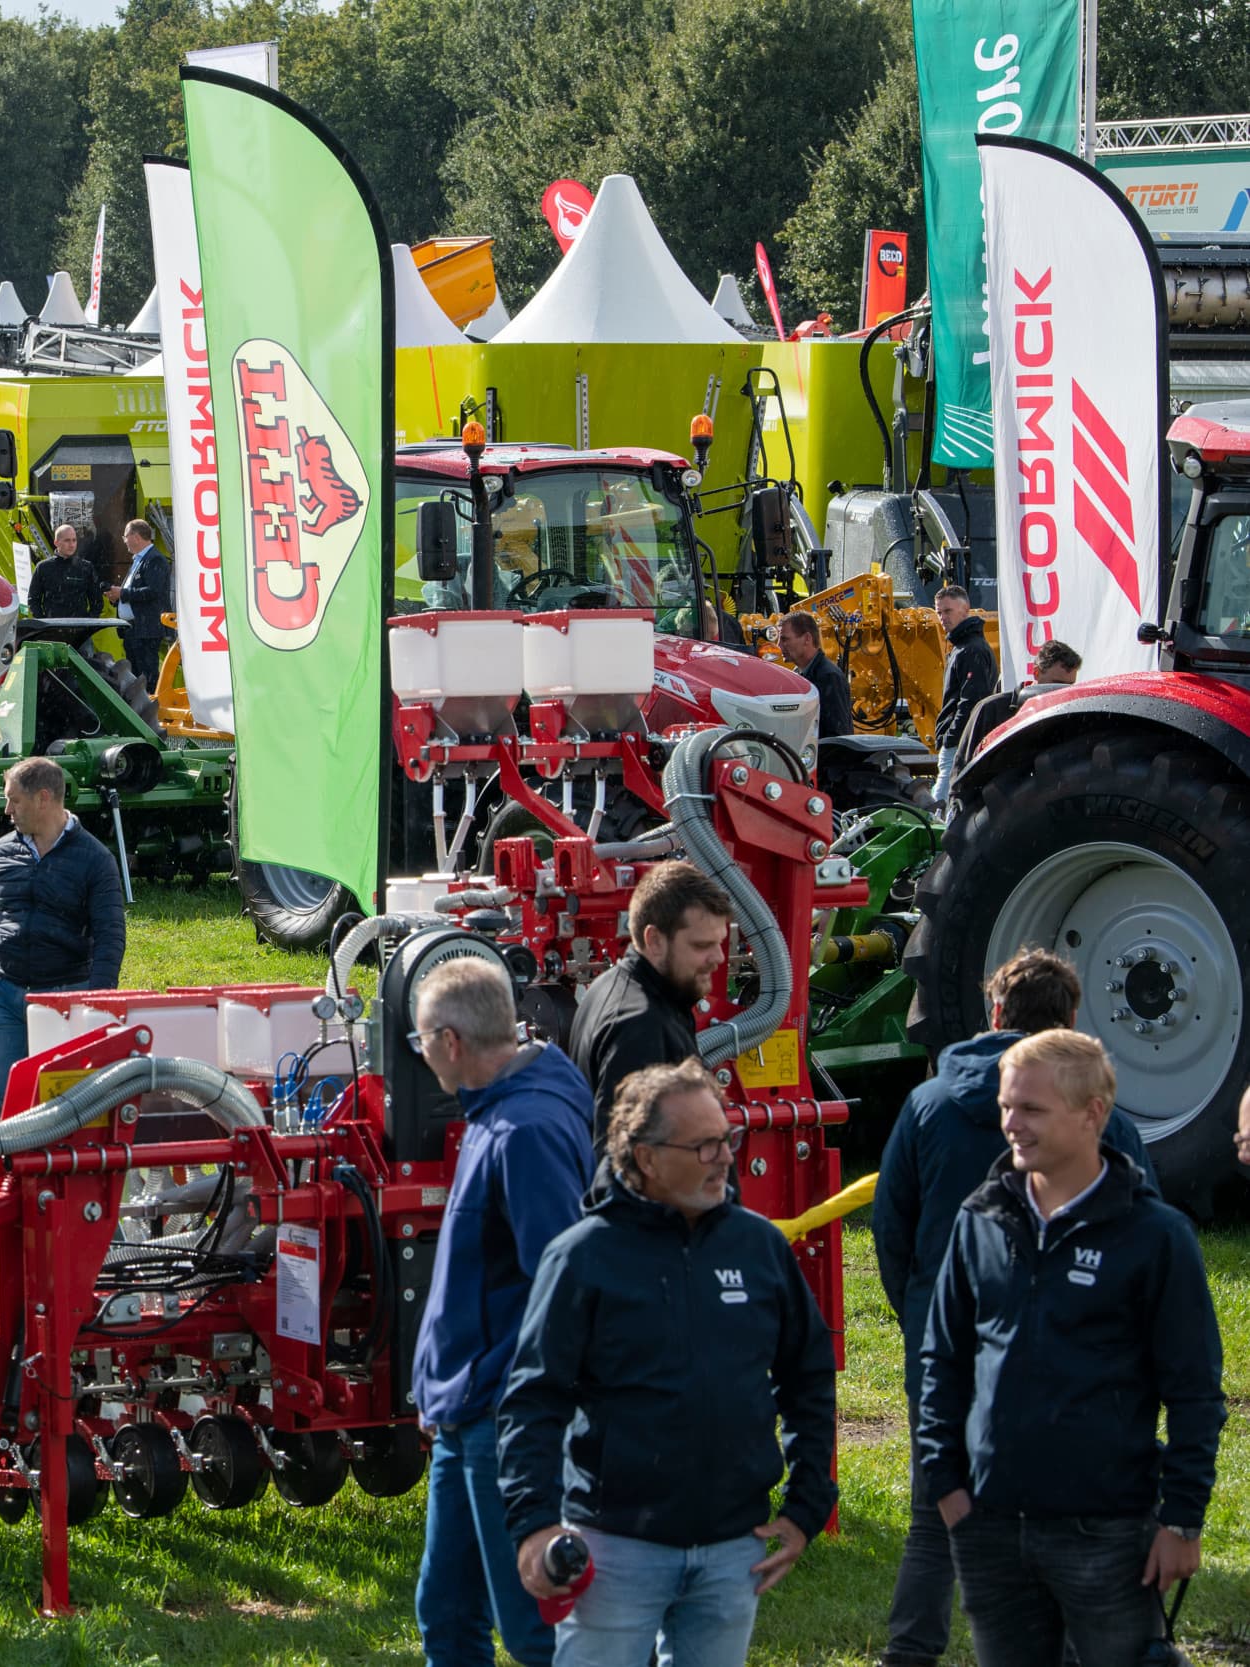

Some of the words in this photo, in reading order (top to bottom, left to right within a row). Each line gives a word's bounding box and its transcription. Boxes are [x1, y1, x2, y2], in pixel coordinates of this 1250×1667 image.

[879, 249, 903, 263] BECO
[1075, 1246, 1103, 1267] VH
[714, 1268, 743, 1285] VH
